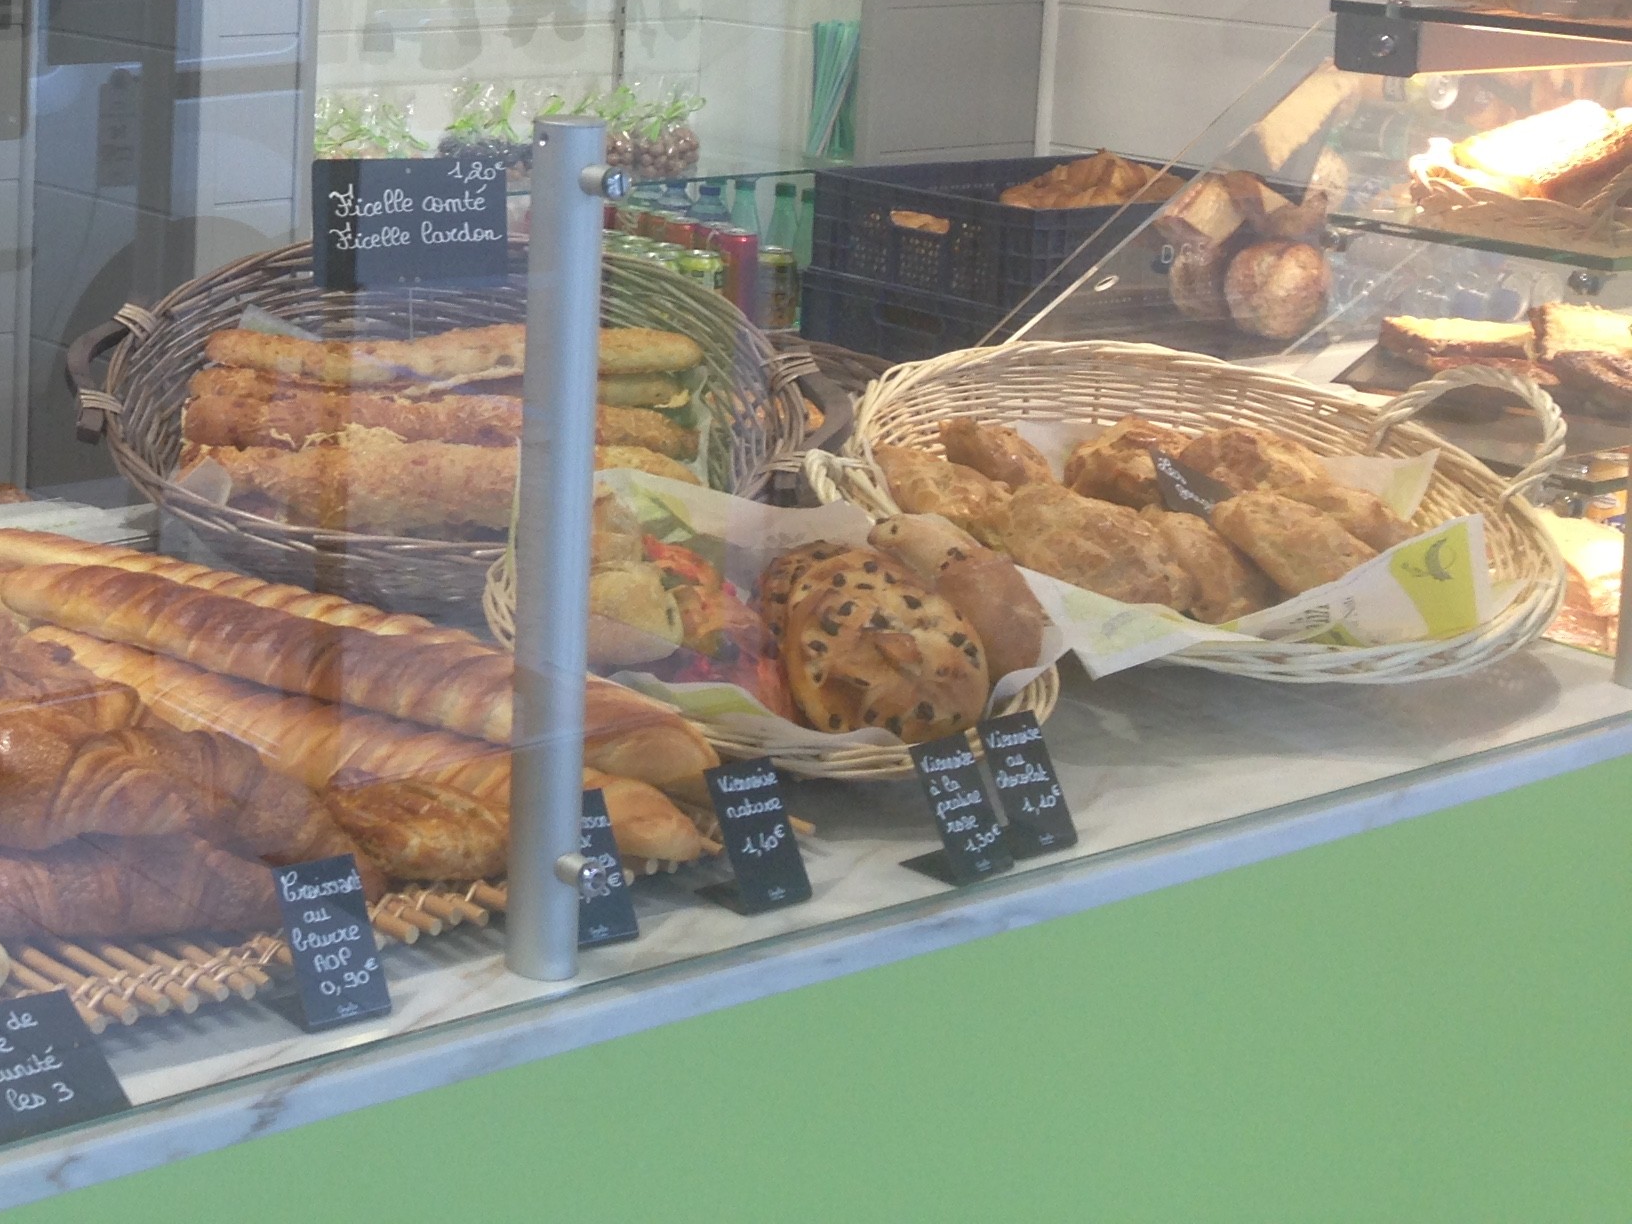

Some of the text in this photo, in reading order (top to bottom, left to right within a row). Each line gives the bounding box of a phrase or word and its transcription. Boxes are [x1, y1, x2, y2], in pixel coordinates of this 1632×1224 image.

[328, 183, 488, 217] Ficelle comté
[328, 220, 503, 250] Ficelle lardon
[726, 797, 783, 818] nature
[303, 907, 332, 924] au
[291, 925, 361, 951] beurre
[312, 947, 352, 973] AOP
[6, 1011, 38, 1030] de
[5, 1088, 46, 1111] les
[51, 1081, 74, 1103] 3
